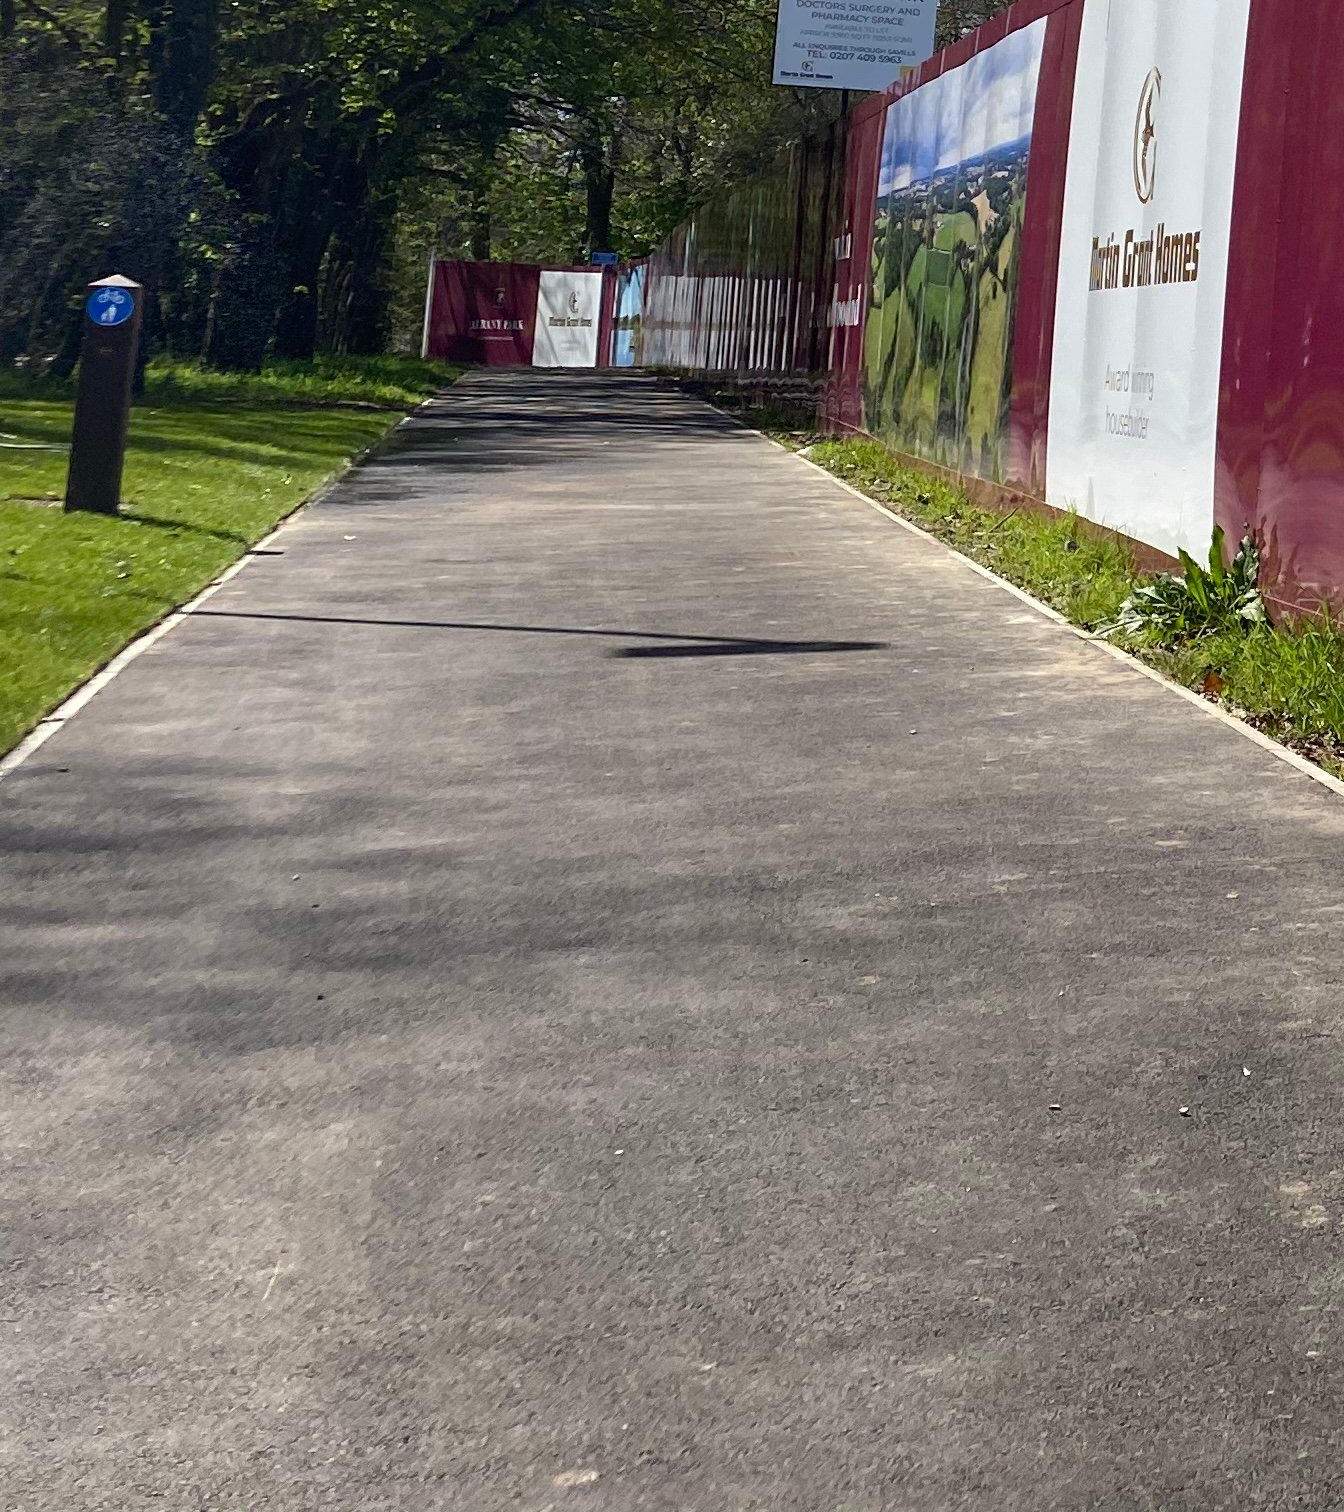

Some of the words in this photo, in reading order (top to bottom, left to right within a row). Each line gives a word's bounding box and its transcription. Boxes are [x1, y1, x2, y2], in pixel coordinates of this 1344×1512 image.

[796, 0, 846, 12] DOCTORS
[849, 3, 895, 15] SURGERY
[897, 7, 920, 17] AND
[811, 11, 869, 23] PHARMACY
[871, 15, 904, 26] SPACE
[829, 51, 855, 61] 0207
[856, 54, 876, 63] 409
[878, 55, 902, 64] 5963
[1154, 222, 1201, 285] Homes
